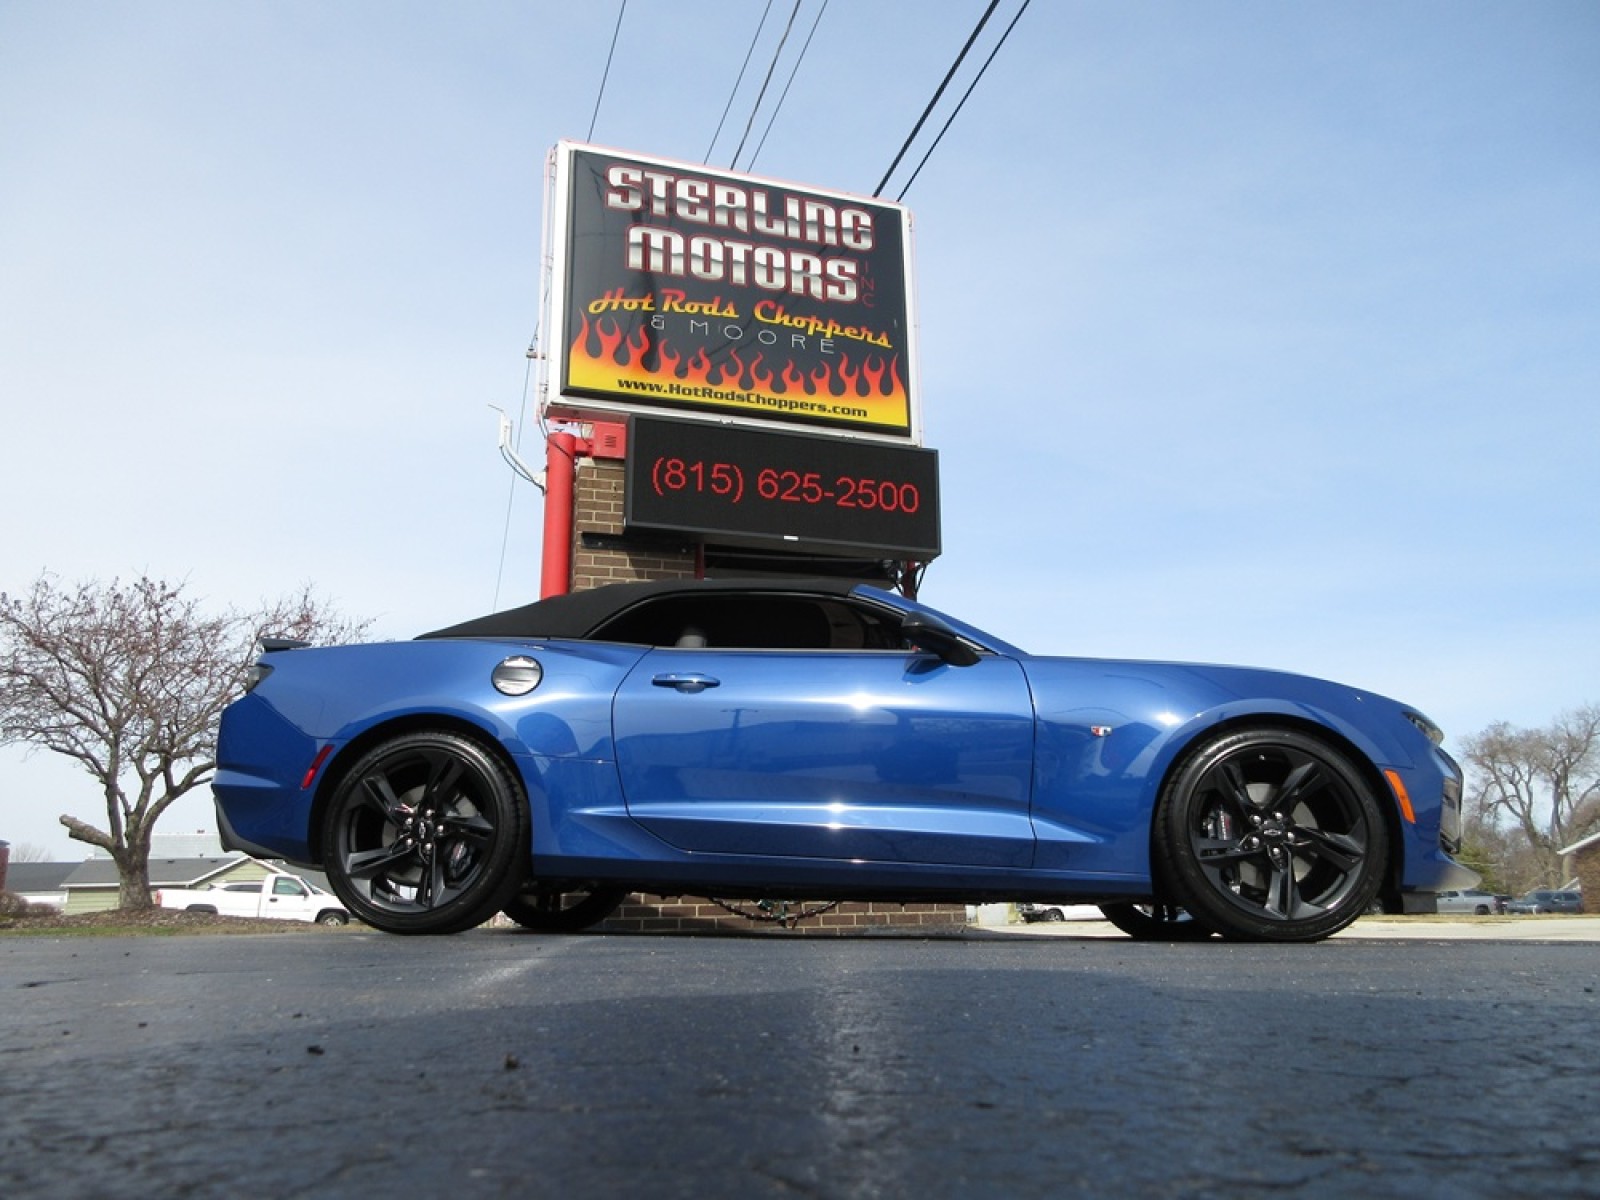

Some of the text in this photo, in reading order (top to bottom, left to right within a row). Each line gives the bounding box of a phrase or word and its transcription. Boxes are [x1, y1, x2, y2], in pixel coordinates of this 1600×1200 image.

[606, 165, 874, 250] STERLING
[627, 225, 858, 302] MOTORS
[588, 287, 893, 349] Hot Rods Choppers
[650, 314, 835, 355] & MOORE
[617, 378, 868, 418] www.HotRodsChoppers.com
[652, 457, 920, 513] (815) 625-2500
